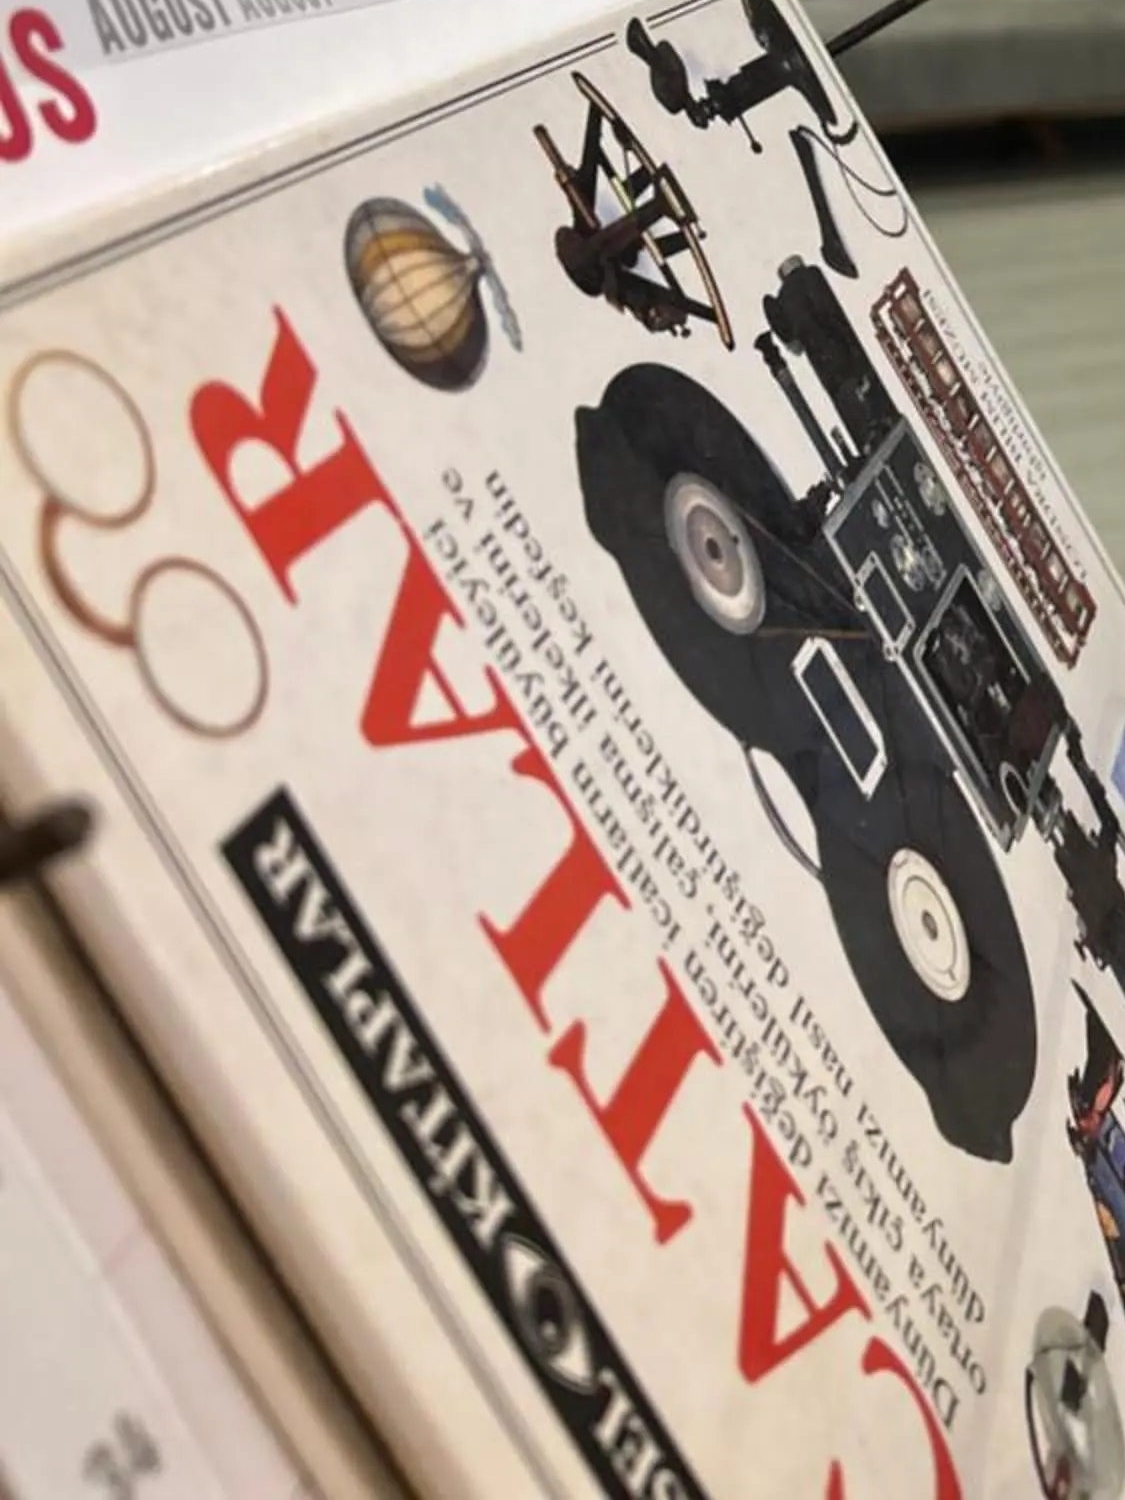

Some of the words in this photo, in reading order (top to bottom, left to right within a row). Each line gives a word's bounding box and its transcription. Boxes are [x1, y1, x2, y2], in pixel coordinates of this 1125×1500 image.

[442, 468, 474, 521] ve
[486, 470, 593, 655] keşfedin
[424, 518, 569, 760] büyüleyici
[476, 532, 597, 729] ilkelerini
[572, 760, 681, 949] icatların
[591, 660, 789, 987] değiştirdiklerini
[600, 733, 700, 899] çalışma
[253, 815, 514, 1250] KİTAPLAR
[684, 950, 812, 1168] değiştiren
[789, 996, 853, 1097] nasıl
[843, 1140, 903, 1252] çıkış
[857, 1104, 985, 1323] dünyamızı
[816, 1174, 960, 1429] Dünyamızı
[909, 1256, 988, 1396] ortaya
